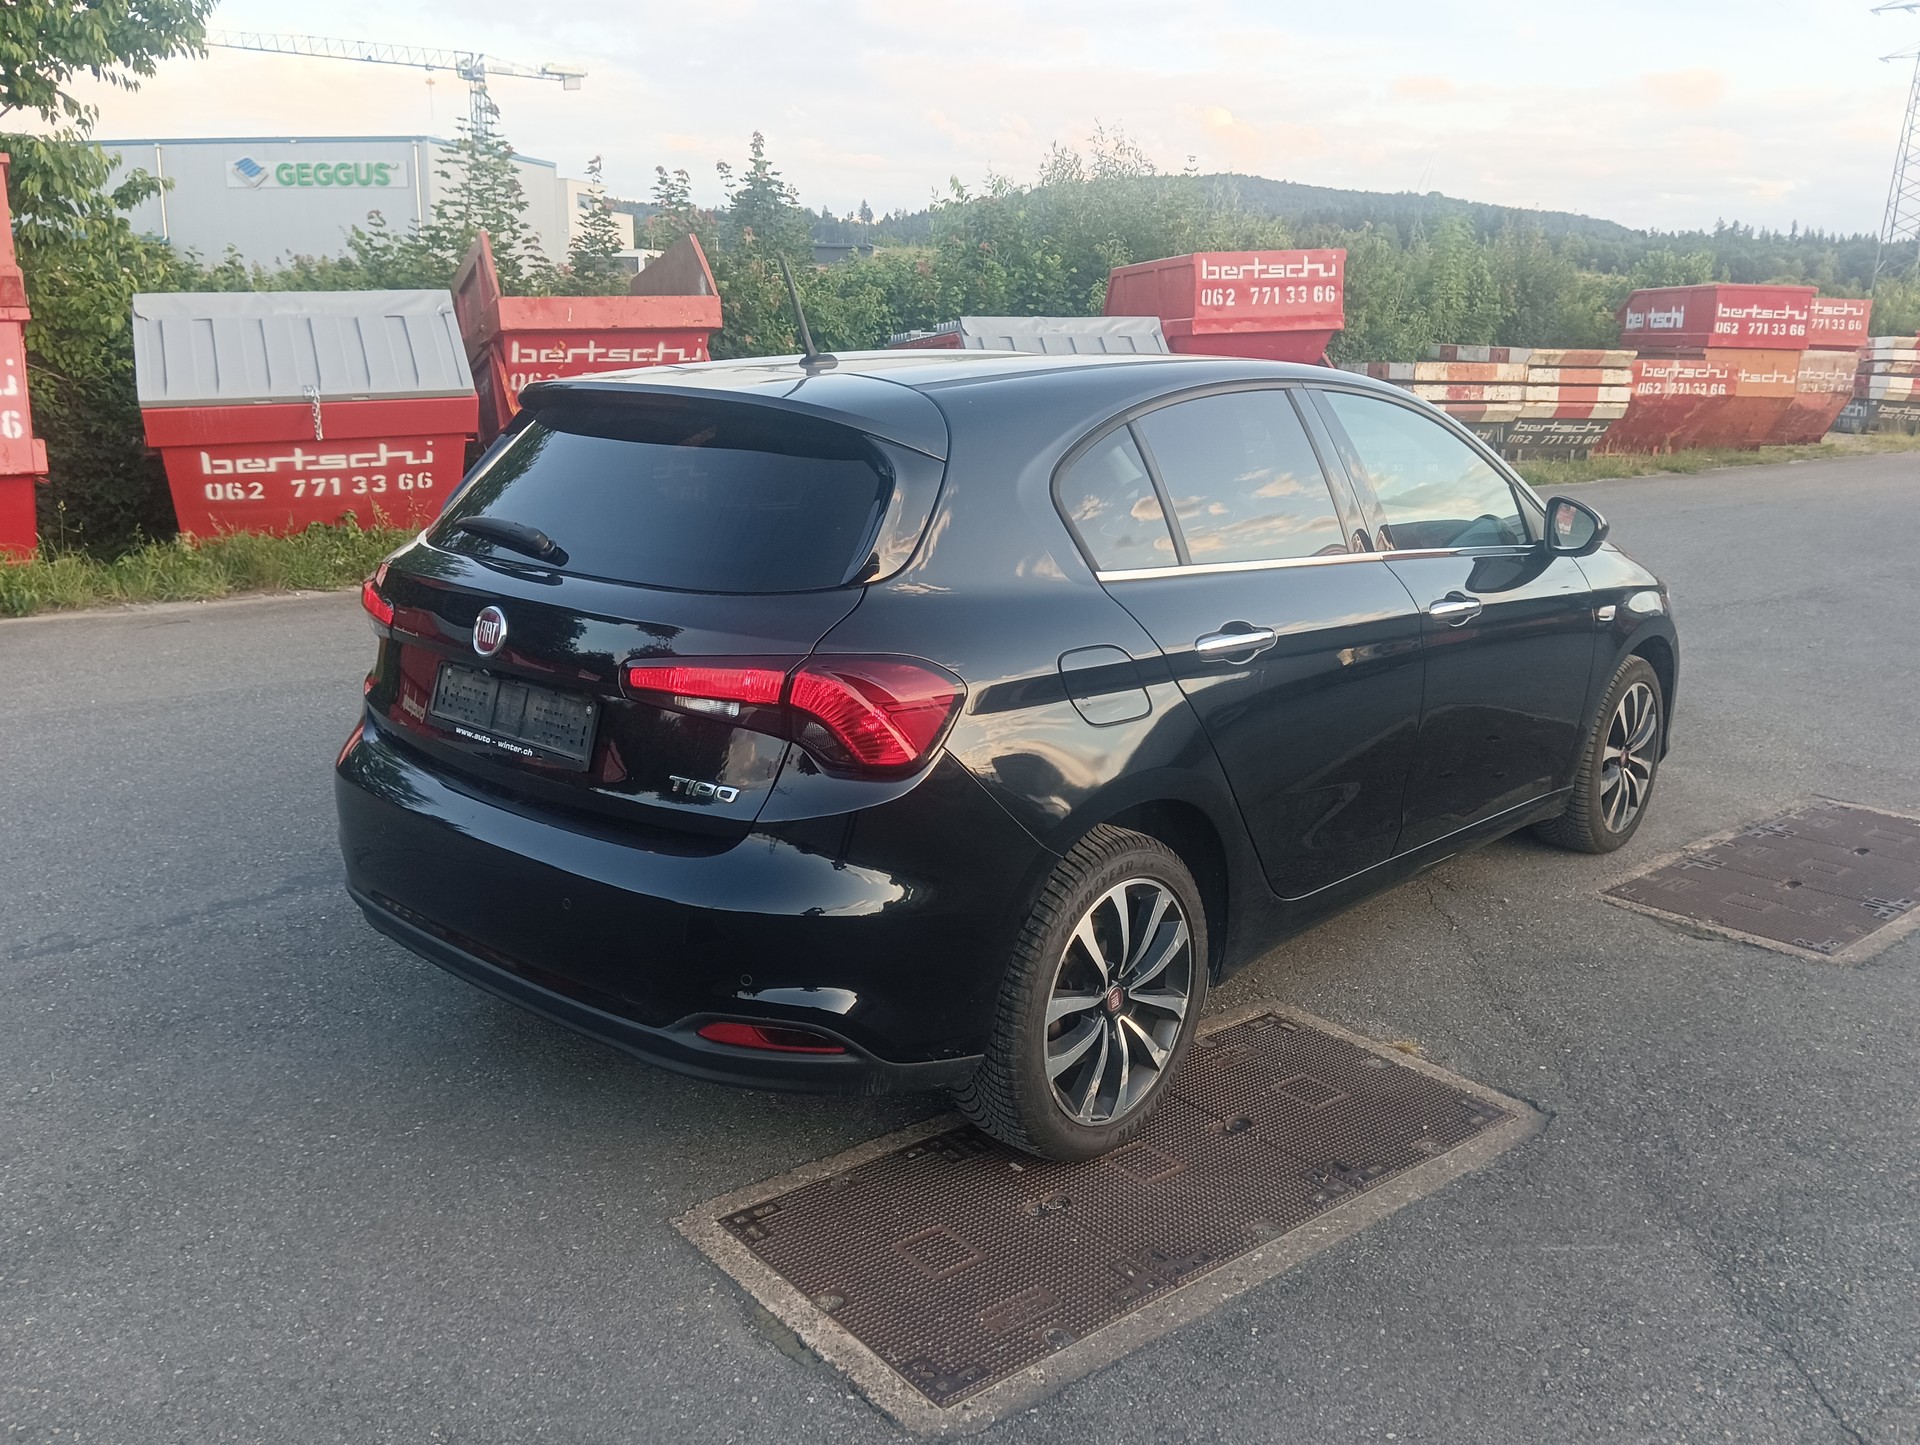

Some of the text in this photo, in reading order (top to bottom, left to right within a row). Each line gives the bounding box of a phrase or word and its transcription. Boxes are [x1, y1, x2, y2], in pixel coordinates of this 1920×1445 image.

[275, 162, 391, 187] GEGGUS
[1202, 254, 1337, 279] bertschi
[1201, 285, 1336, 306] 062 771 33 66
[1625, 304, 1685, 329] betschi
[1717, 303, 1808, 320] bertschi
[1810, 301, 1865, 316] tschi
[1715, 322, 1806, 337] 062 771 33 66
[1832, 319, 1846, 330] 33
[1848, 319, 1863, 331] 66
[511, 338, 703, 363] bertschi
[1641, 361, 1729, 378] bertschi
[1738, 368, 1796, 384] tschi
[1637, 382, 1662, 395] 062
[1710, 383, 1727, 396] 66
[1, 410, 23, 439] 6
[1514, 421, 1612, 433] bertschi
[1507, 434, 1533, 444] 062
[1540, 435, 1564, 444] 771
[1565, 435, 1581, 444] 33
[200, 440, 434, 475] bertschi
[205, 472, 433, 500] 062 771 33 66
[479, 619, 499, 645] FIAT
[455, 726, 491, 744] www.auto
[497, 740, 533, 757] winter.ch
[668, 774, 740, 803] TIPO
